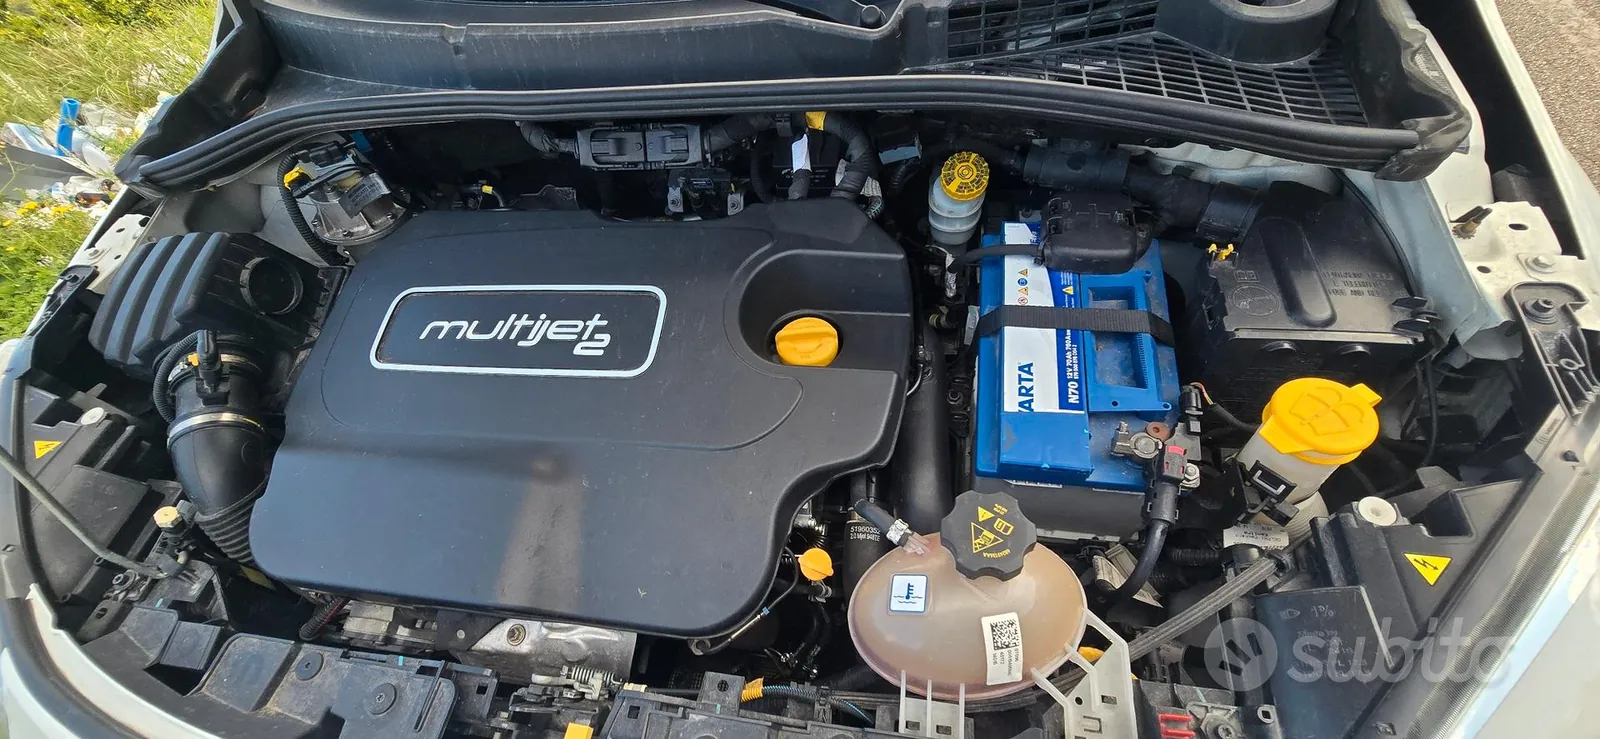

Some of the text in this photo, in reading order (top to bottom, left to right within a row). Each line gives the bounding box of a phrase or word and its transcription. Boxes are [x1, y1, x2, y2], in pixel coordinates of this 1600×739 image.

[1065, 351, 1073, 367] 70Ah
[1017, 362, 1034, 413] ARTA
[1067, 381, 1080, 404] N70
